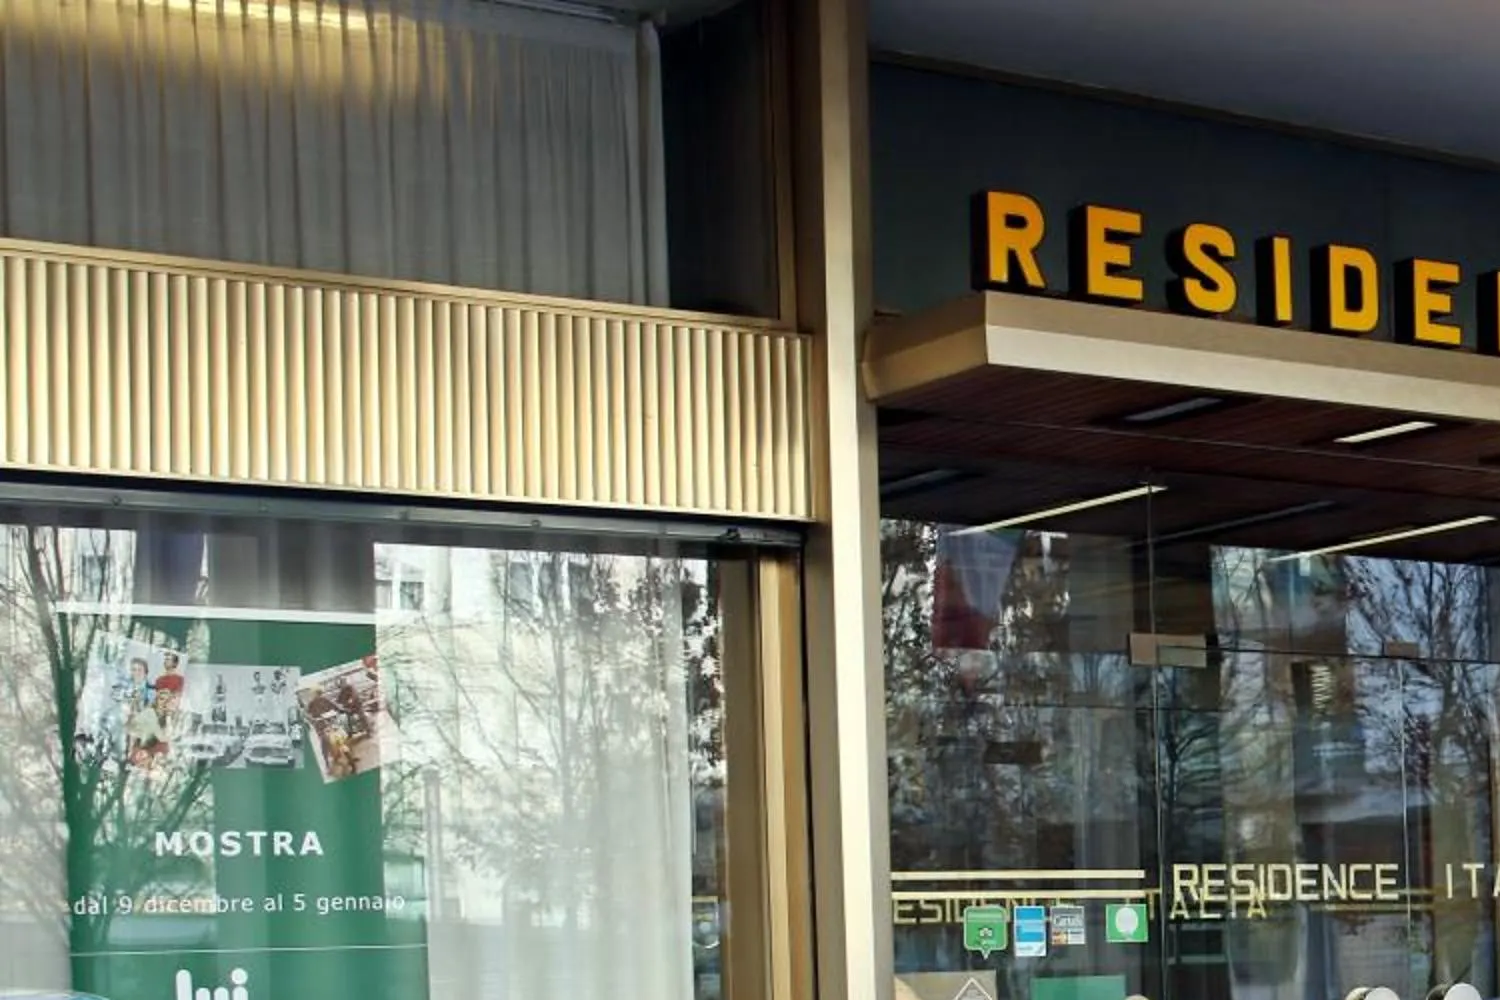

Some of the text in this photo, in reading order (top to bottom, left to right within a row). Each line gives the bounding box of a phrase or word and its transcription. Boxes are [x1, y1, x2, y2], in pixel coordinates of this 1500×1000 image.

[154, 830, 325, 858] MOSTRA
[1172, 863, 1399, 901] RESIDENCE
[73, 892, 406, 916] dal 9 dicembre al 5 gennaio
